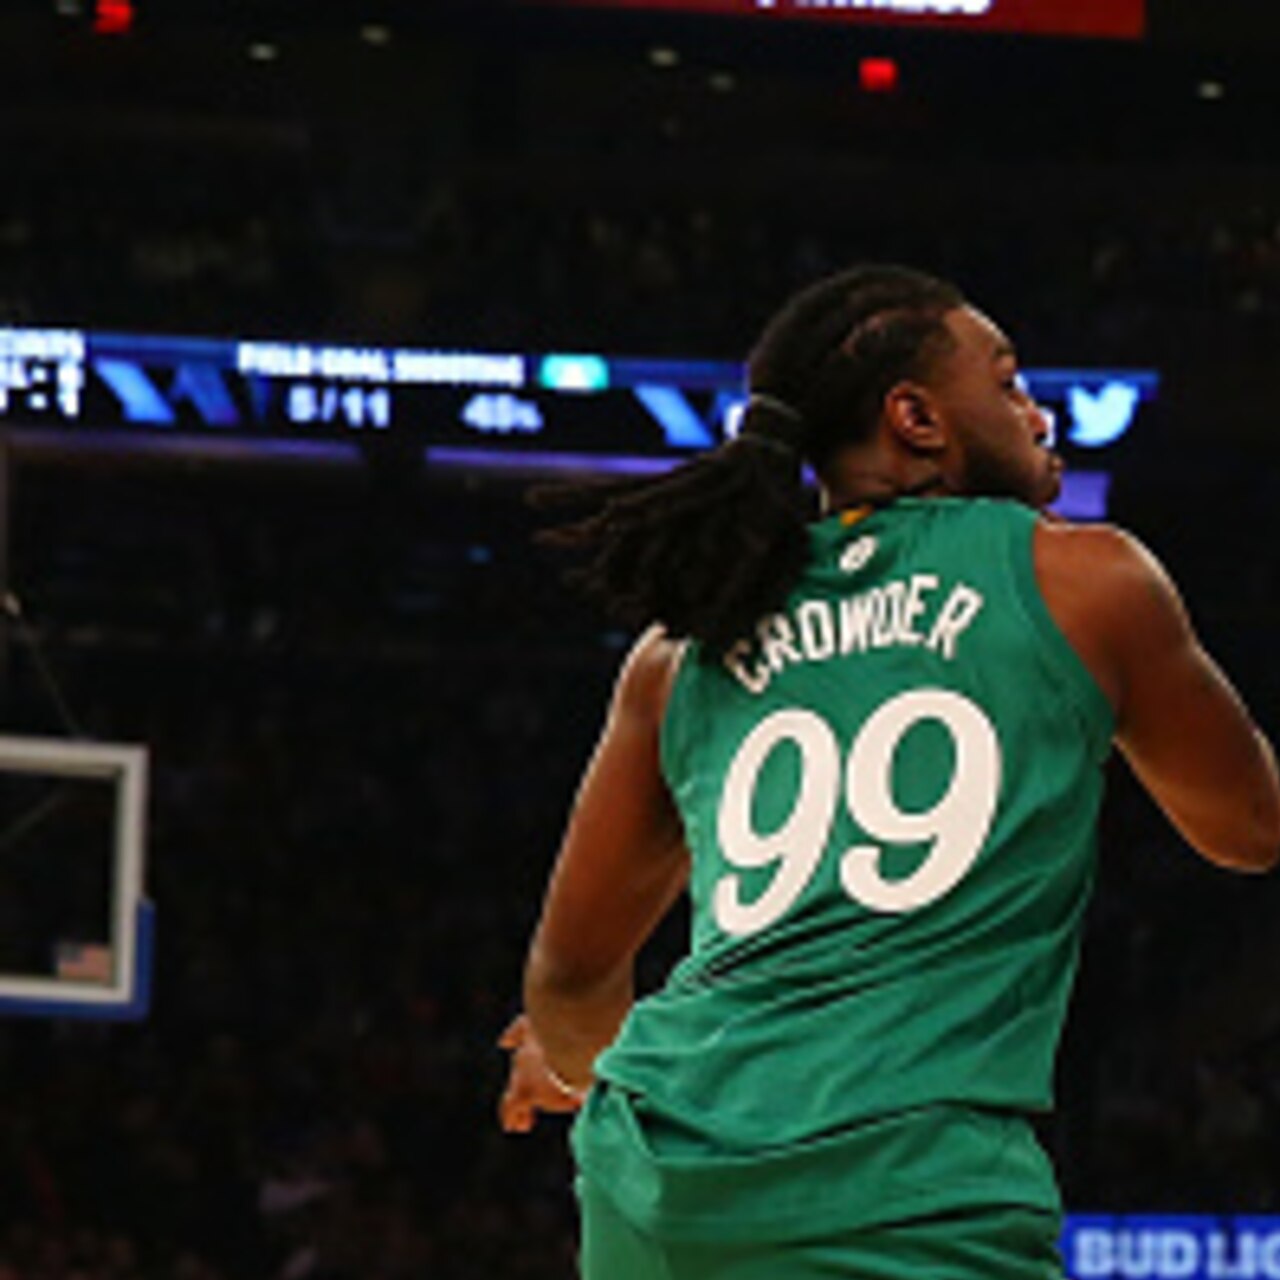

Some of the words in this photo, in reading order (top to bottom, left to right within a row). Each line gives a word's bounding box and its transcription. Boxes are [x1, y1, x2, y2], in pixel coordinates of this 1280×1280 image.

[724, 573, 984, 694] CROWDER
[712, 687, 1003, 938] 99
[1074, 1228, 1199, 1280] BUD
